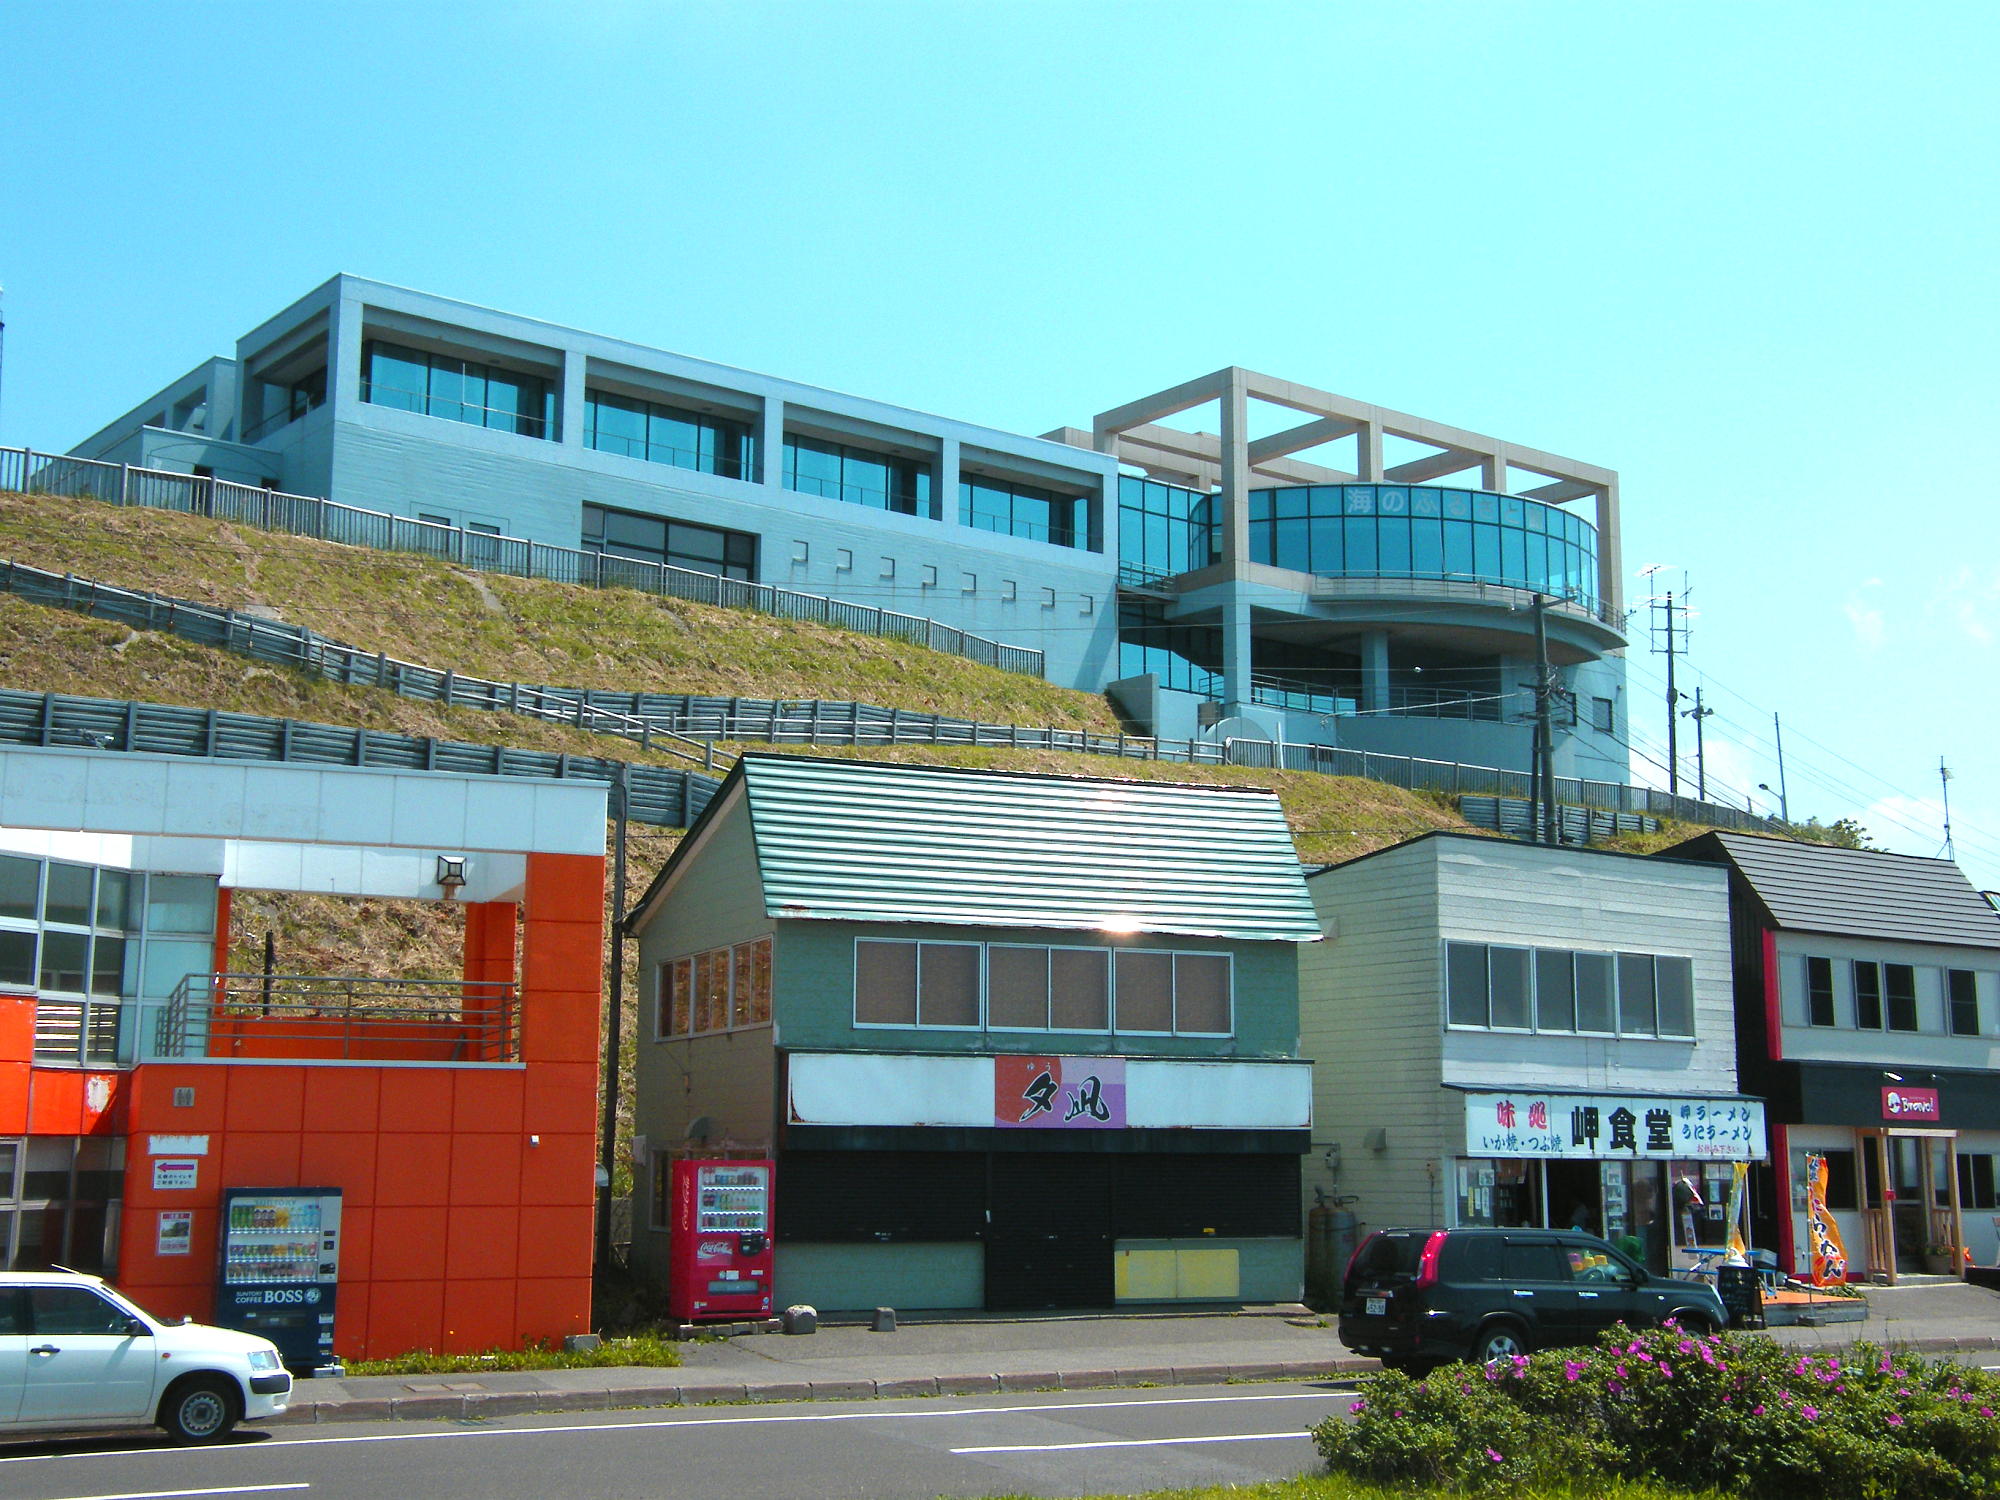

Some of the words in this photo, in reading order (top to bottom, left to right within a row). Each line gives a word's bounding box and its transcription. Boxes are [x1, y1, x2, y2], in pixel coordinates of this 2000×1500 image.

[1570, 1104, 1674, 1152] 岬食堂
[1681, 1123, 1752, 1141] うにラーメン
[1482, 1132, 1564, 1153] いか焼・つぶ焼
[235, 1296, 263, 1304] COFFEE
[264, 1289, 303, 1304] BOSS
